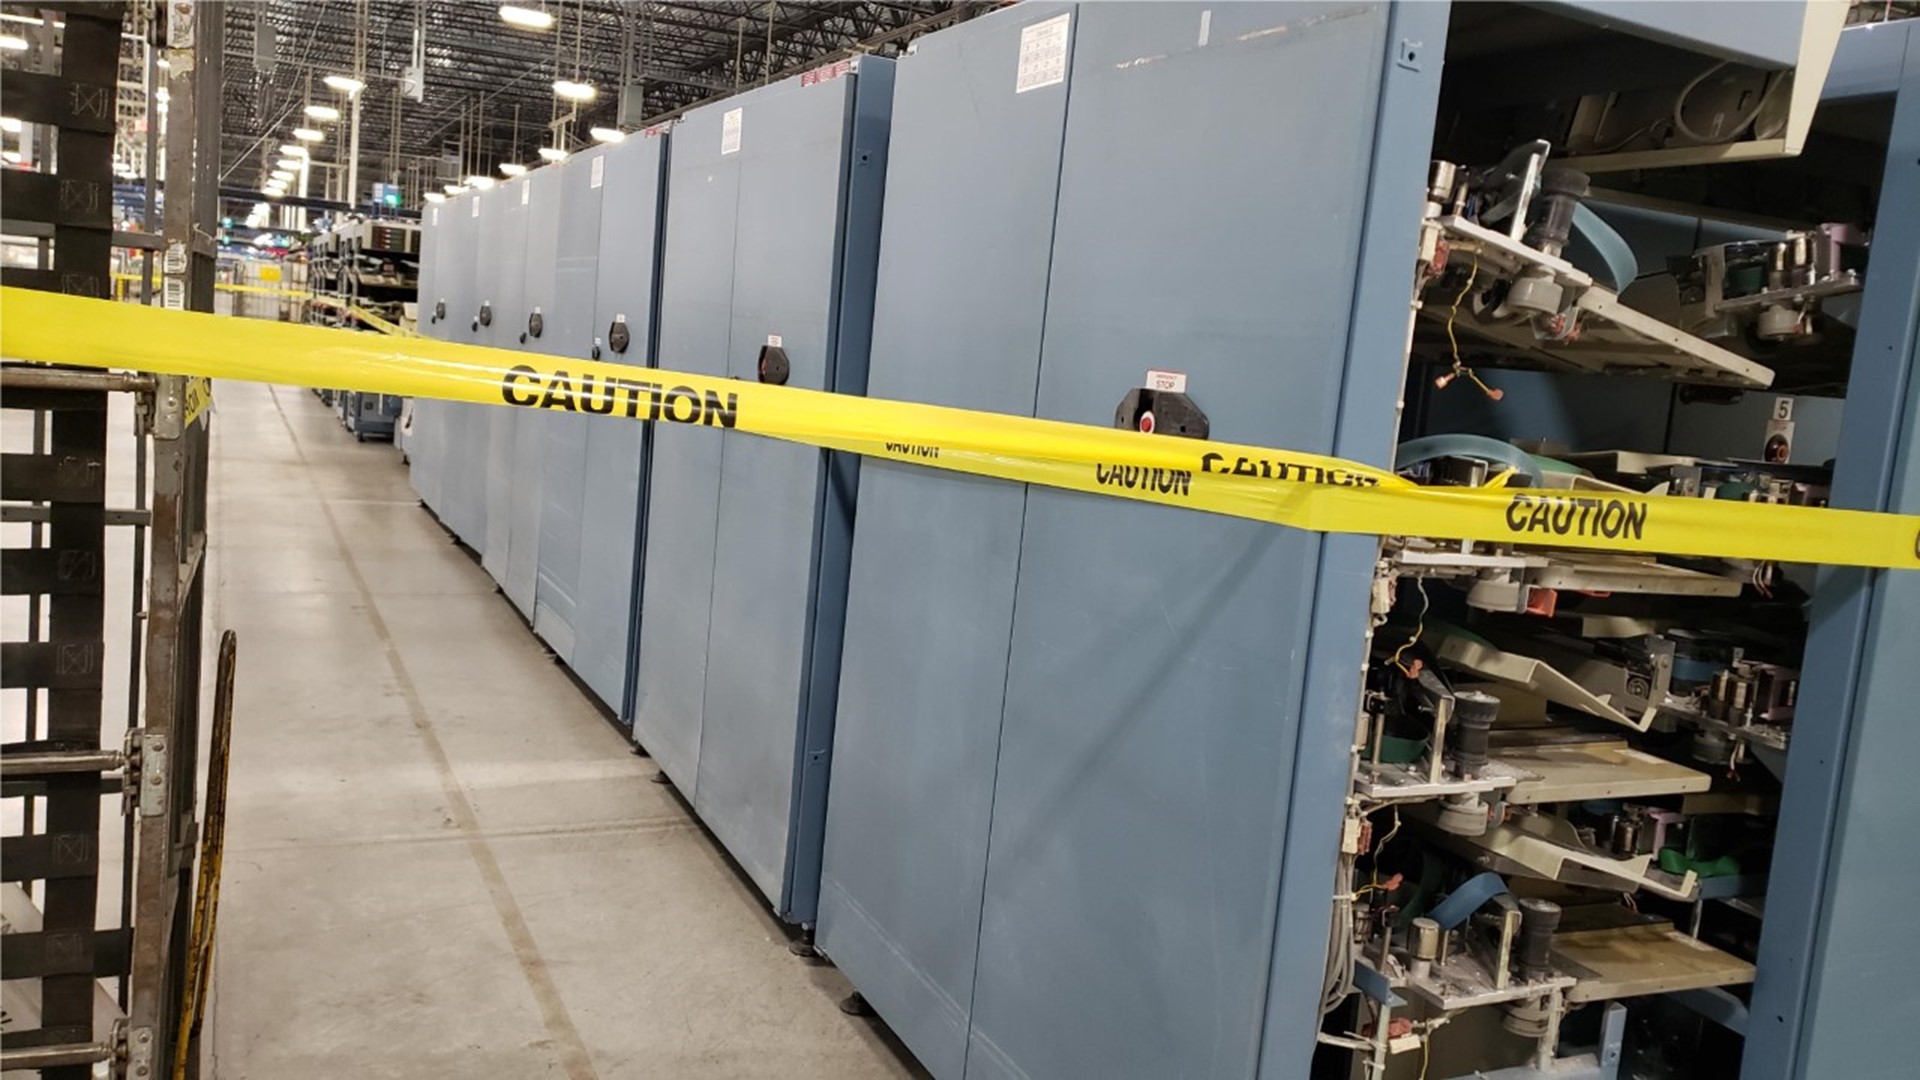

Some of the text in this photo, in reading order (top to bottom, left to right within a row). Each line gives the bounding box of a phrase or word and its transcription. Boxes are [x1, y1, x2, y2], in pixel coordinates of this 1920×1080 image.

[502, 364, 739, 428] CAUTION
[1779, 400, 1789, 419] 5
[1096, 462, 1192, 496] CAUTION
[1506, 493, 1648, 540] CAUTION
